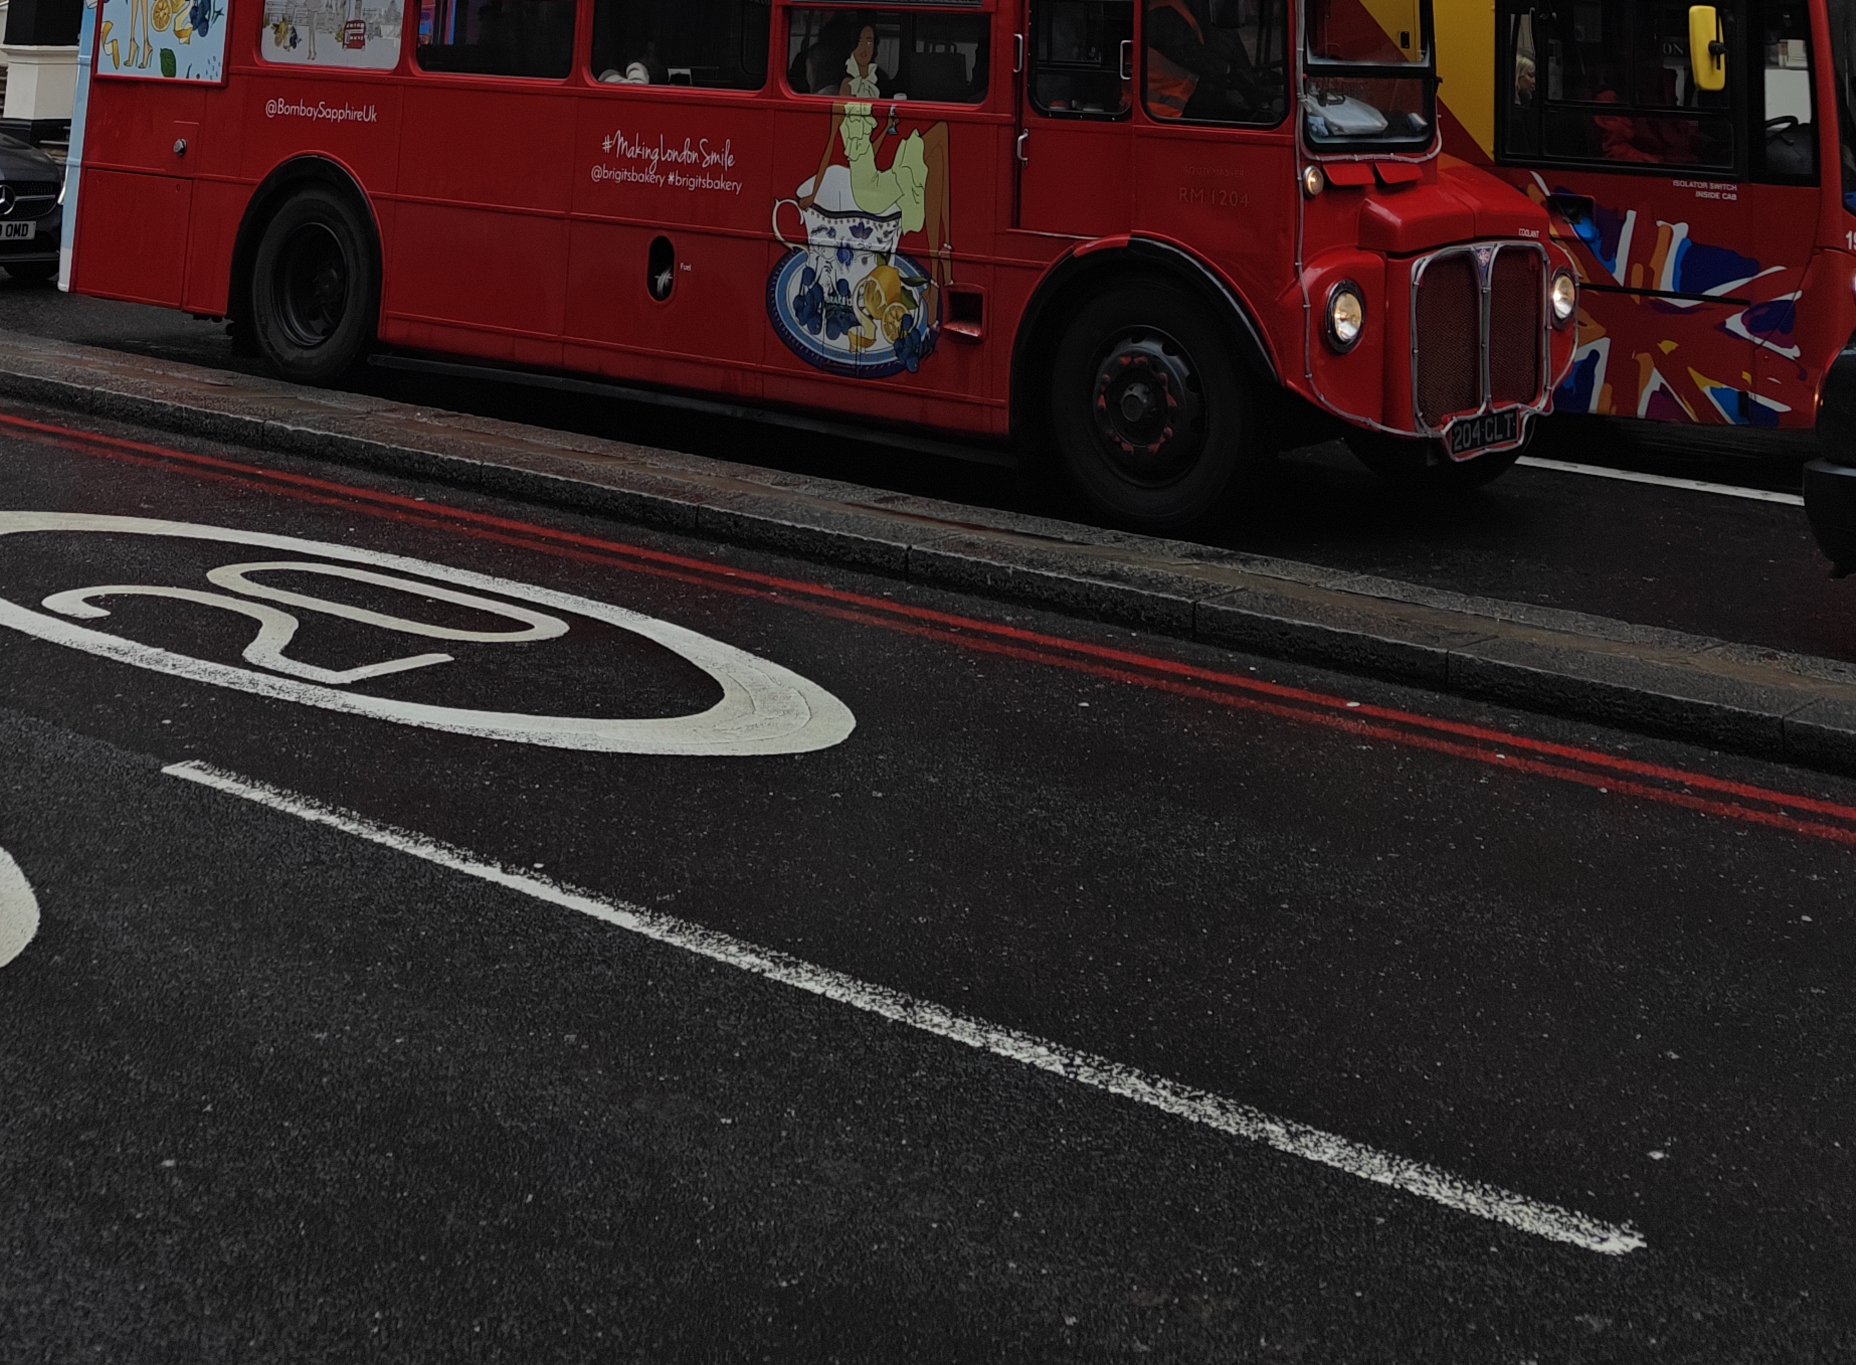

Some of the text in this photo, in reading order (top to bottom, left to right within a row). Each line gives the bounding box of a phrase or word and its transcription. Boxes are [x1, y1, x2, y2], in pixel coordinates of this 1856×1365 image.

[265, 98, 378, 123] @BombaySapphireUk
[591, 163, 743, 195] @brigitsbakery #brigitsbakery
[1673, 179, 1738, 192] ISOLATOR SWITCH
[1179, 186, 1250, 207] RM 1204
[1695, 190, 1738, 201] INSIDE CAB
[5, 224, 29, 237] OMD
[1518, 228, 1540, 238] COOLANT
[680, 262, 692, 272] Fuel
[41, 560, 571, 685] 20
